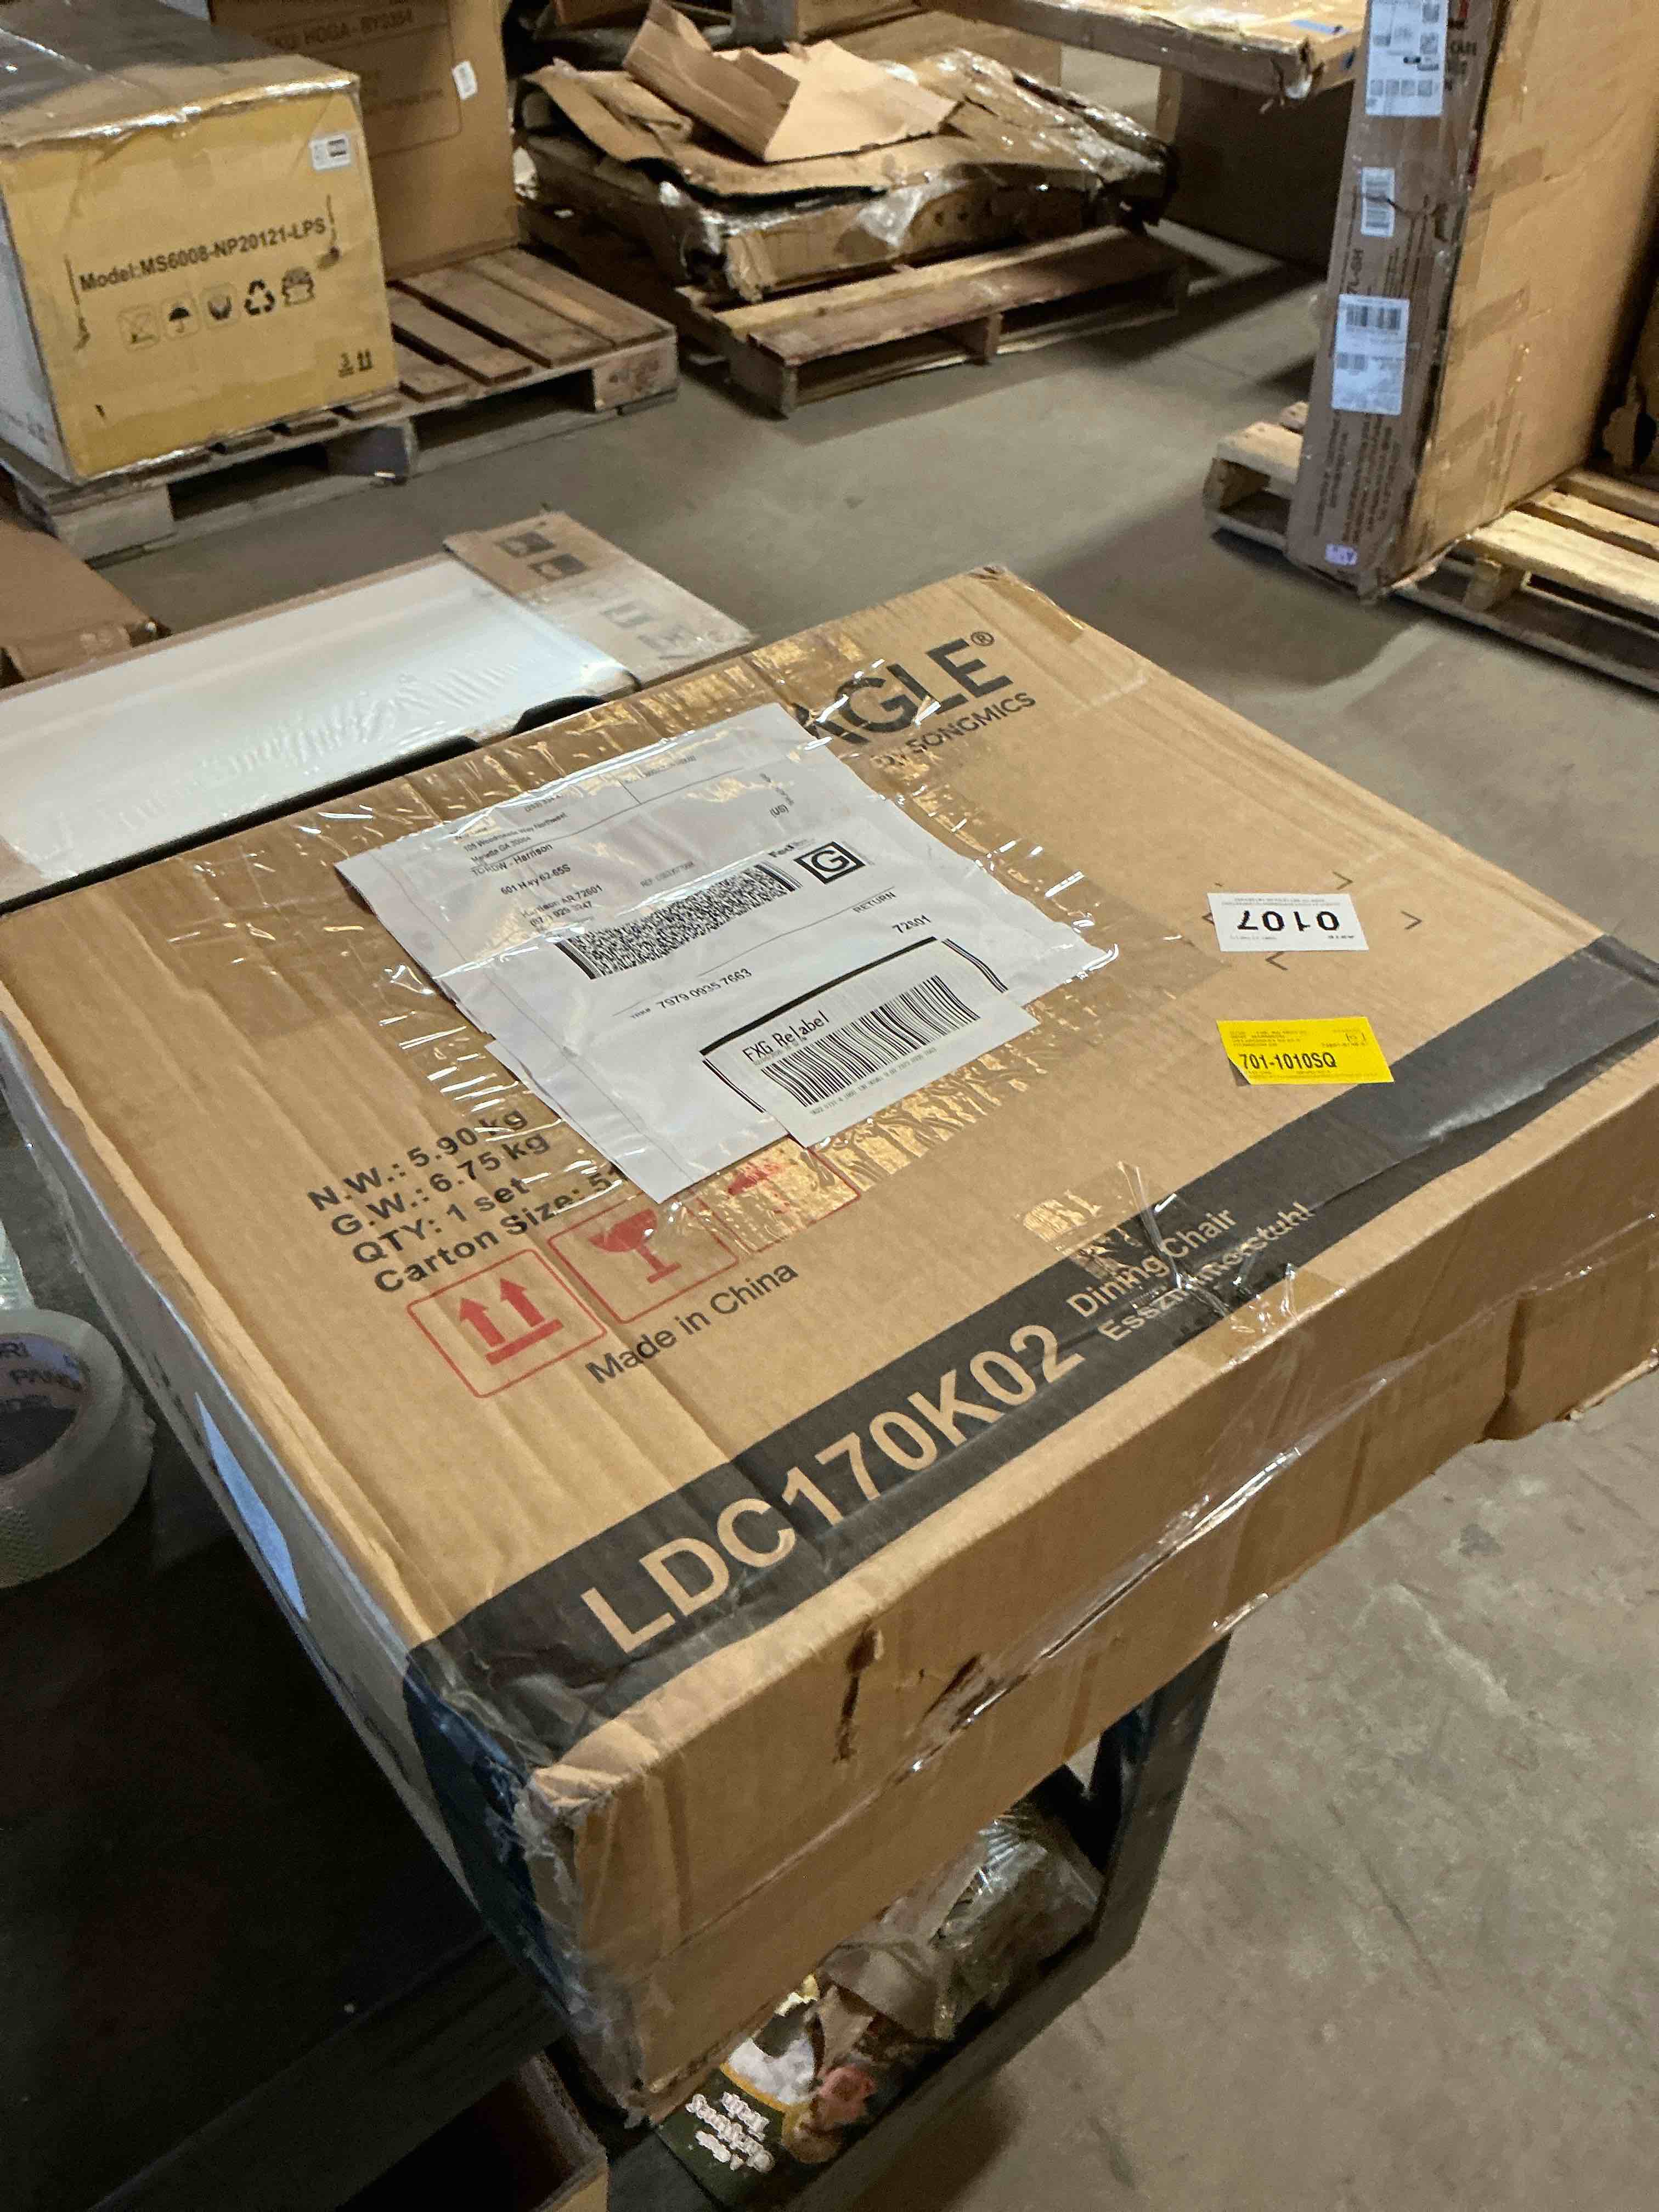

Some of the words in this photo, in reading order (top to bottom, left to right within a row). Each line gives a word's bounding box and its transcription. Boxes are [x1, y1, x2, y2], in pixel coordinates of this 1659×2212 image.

[906, 693, 1036, 754] SONGMICS
[811, 850, 850, 872] G
[852, 891, 896, 913] RETURN
[1237, 910, 1340, 932] 0107
[656, 992, 690, 1009] 7979
[689, 982, 721, 997] 0935
[719, 968, 753, 985] 7663
[742, 1041, 774, 1063] FXG
[772, 1010, 830, 1047] Relabel
[1238, 1051, 1339, 1071] 701-1010SQ
[407, 1127, 478, 1167] 5.90
[429, 1151, 501, 1193] 6.75
[501, 1133, 550, 1160] kg
[352, 1218, 442, 1263] QTY:
[446, 1203, 467, 1223] 1
[473, 1176, 530, 1212] set
[374, 1230, 500, 1293] Carton
[1066, 1255, 1171, 1318] Dining
[1159, 1209, 1238, 1259] Chair
[585, 1329, 677, 1384] Made
[674, 1311, 712, 1335] in
[710, 1264, 799, 1314] China
[580, 1323, 1086, 1653] LDC170K02
